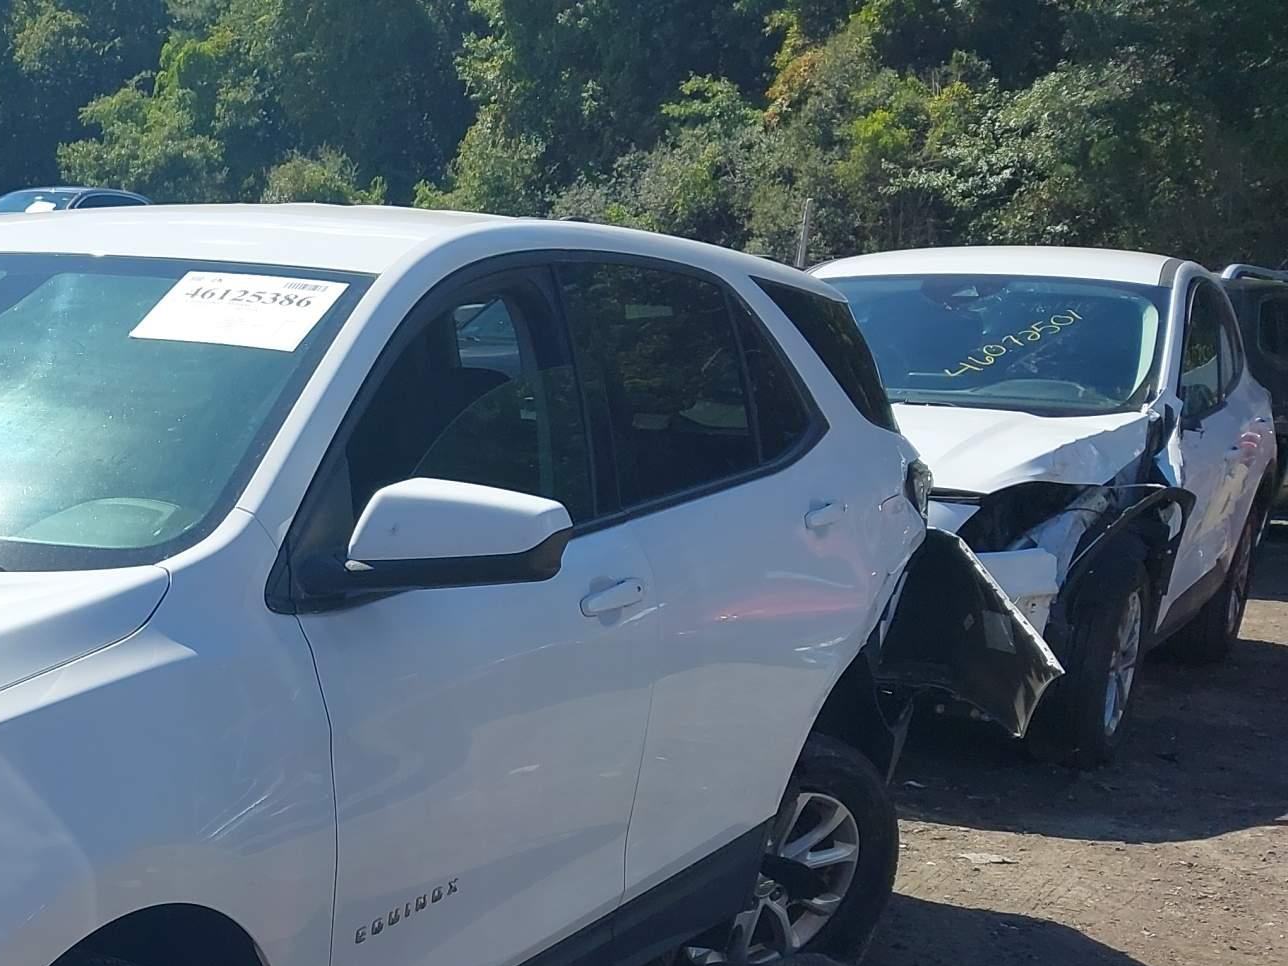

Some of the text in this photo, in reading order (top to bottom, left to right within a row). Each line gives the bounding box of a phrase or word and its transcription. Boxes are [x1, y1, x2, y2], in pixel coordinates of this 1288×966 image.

[184, 286, 313, 309] 46125386
[944, 308, 1084, 377] 46072501
[354, 877, 460, 945] EQUINOX
